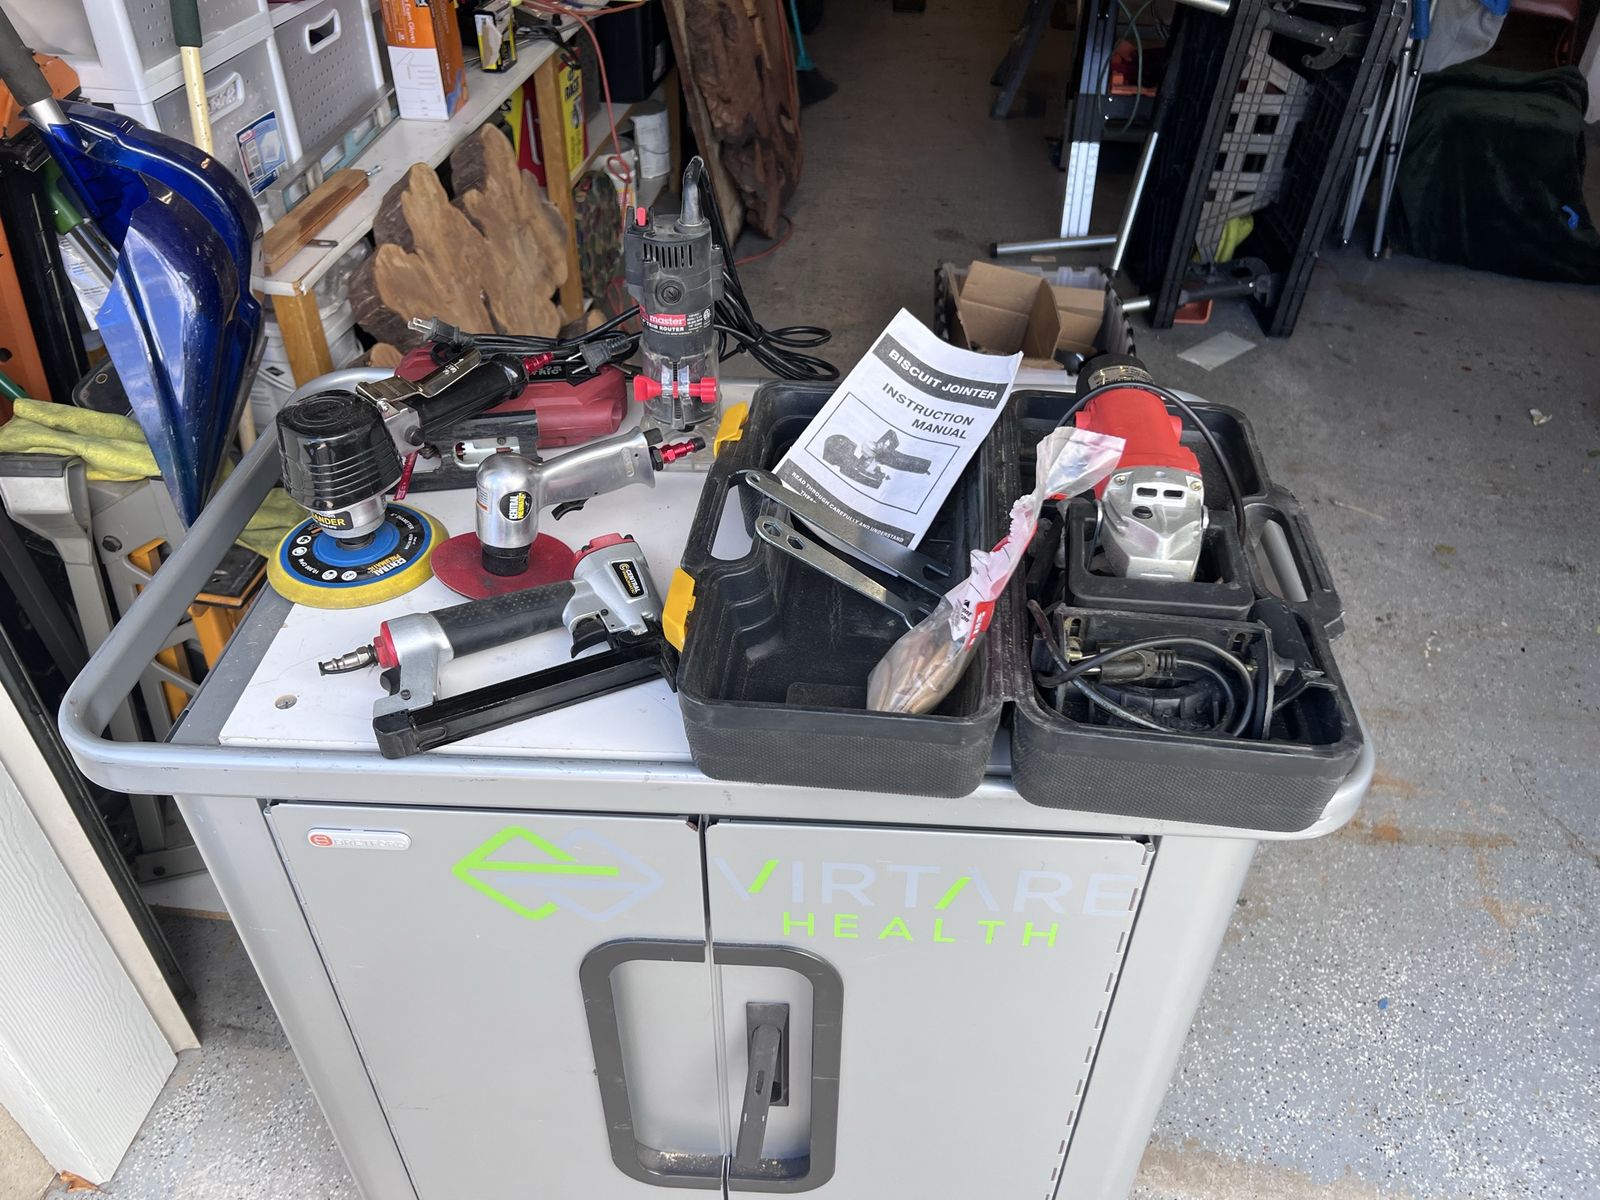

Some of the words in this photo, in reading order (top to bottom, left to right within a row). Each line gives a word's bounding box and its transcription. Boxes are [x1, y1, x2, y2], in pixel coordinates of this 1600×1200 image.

[408, 21, 416, 43] Gloves
[649, 314, 684, 326] master
[888, 349, 942, 388] BISCUIT
[941, 383, 998, 400] JOINTER
[882, 382, 975, 426] INSTRUCTION
[911, 418, 968, 439] MANUAL
[312, 512, 346, 526] ANDER
[508, 494, 519, 520] CENTRAL
[791, 471, 806, 486] READ
[805, 482, 830, 506] THROUGH
[829, 503, 860, 525] CAREFULLY
[859, 522, 871, 530] AND
[870, 526, 905, 543] UNDERSTAND
[373, 557, 407, 577] CENTRAL
[713, 857, 1138, 916] VIRTARE
[783, 911, 1060, 947] HEALTH
